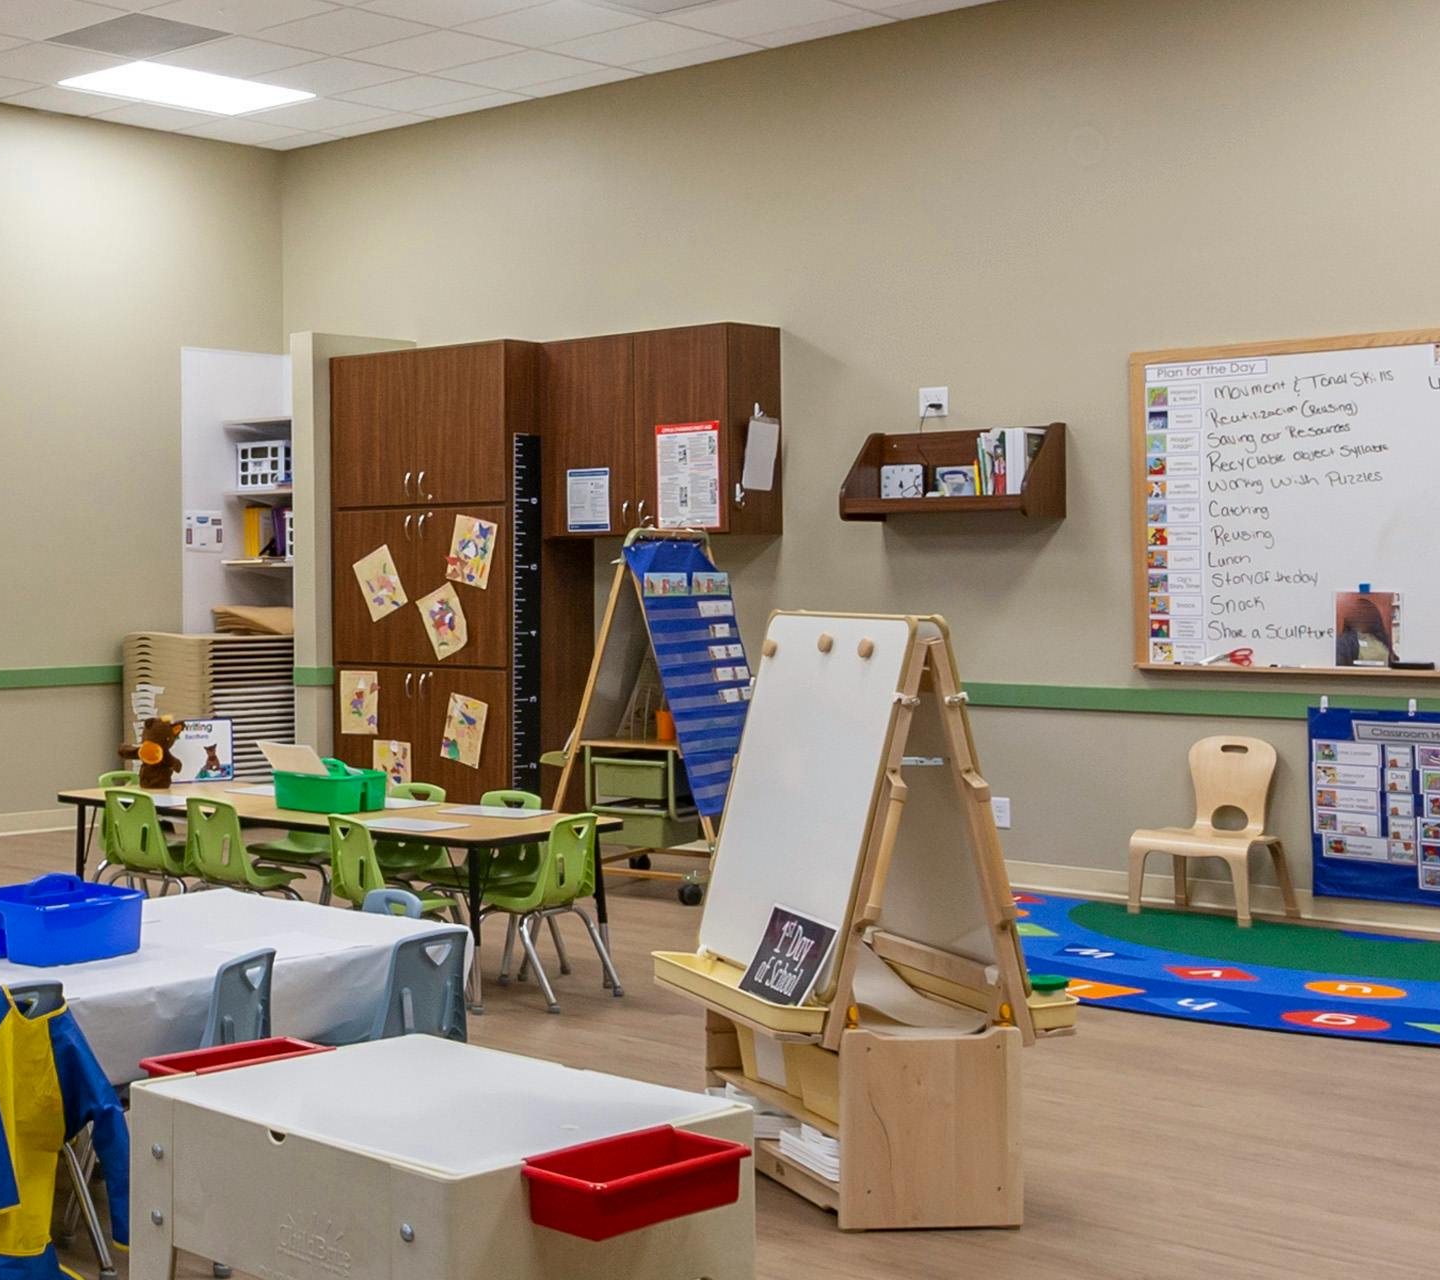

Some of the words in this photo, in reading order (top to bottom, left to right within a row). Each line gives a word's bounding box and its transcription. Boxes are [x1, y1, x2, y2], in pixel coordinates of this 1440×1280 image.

[1156, 368, 1185, 379] Plan
[1186, 365, 1204, 377] for
[1206, 364, 1227, 376] the
[1229, 361, 1257, 376] Day
[1206, 431, 1257, 454] Saving
[1323, 470, 1384, 489] Puzzles
[1207, 499, 1270, 521] Catching
[1209, 524, 1276, 550] Reusing
[1206, 551, 1252, 569] Lunch
[1208, 594, 1266, 617] Snack
[1251, 628, 1262, 640] a
[1265, 623, 1335, 642] Sculpture
[1370, 727, 1430, 740] Classroom
[784, 924, 816, 972] Day
[753, 955, 777, 984] of
[764, 959, 805, 998] School
